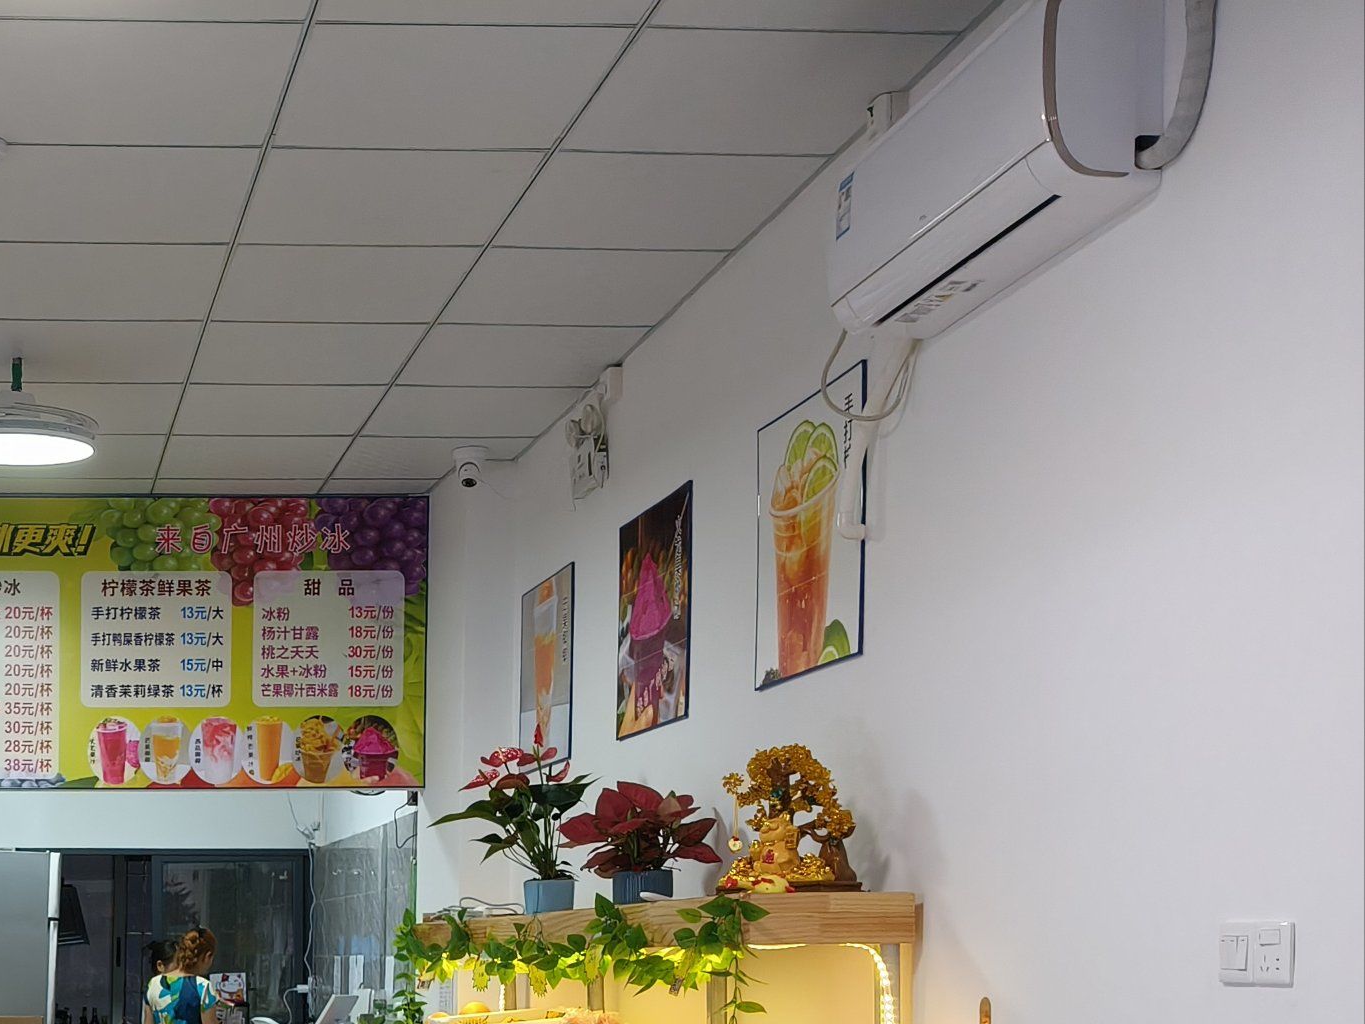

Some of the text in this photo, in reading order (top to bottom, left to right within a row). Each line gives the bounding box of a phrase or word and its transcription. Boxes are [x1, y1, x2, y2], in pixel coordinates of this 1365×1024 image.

[155, 524, 351, 554] 来自广州炒冰
[101, 579, 212, 597] 柠檬茶鲜果茶
[4, 607, 53, 621] 20元/杯
[91, 606, 224, 622] 手打柠檬茶 13元/大
[262, 606, 394, 621] 冰粉 13元/份
[4, 625, 53, 639] 20元/杯
[180, 632, 224, 647] 13元/大
[262, 625, 394, 640] 杨汁甘露 18元/份
[4, 645, 53, 659] 20元/杯
[262, 645, 394, 660] 桃之夭夭 30元/份
[4, 664, 53, 678] 20元/杯
[90, 658, 223, 673] 新鲜水果茶 15元/中
[261, 664, 394, 680] 水果+冰粉 15元/份
[4, 683, 53, 697] 20元/杯
[90, 684, 223, 700] 清香茉莉绿茶 13元/杯
[261, 684, 393, 699] 芒果椰汁西米露 18元/份
[4, 702, 53, 716] 35元/杯
[4, 721, 53, 735] 30元/杯
[4, 740, 53, 754] 28元/杯
[4, 759, 53, 773] 38元/杯
